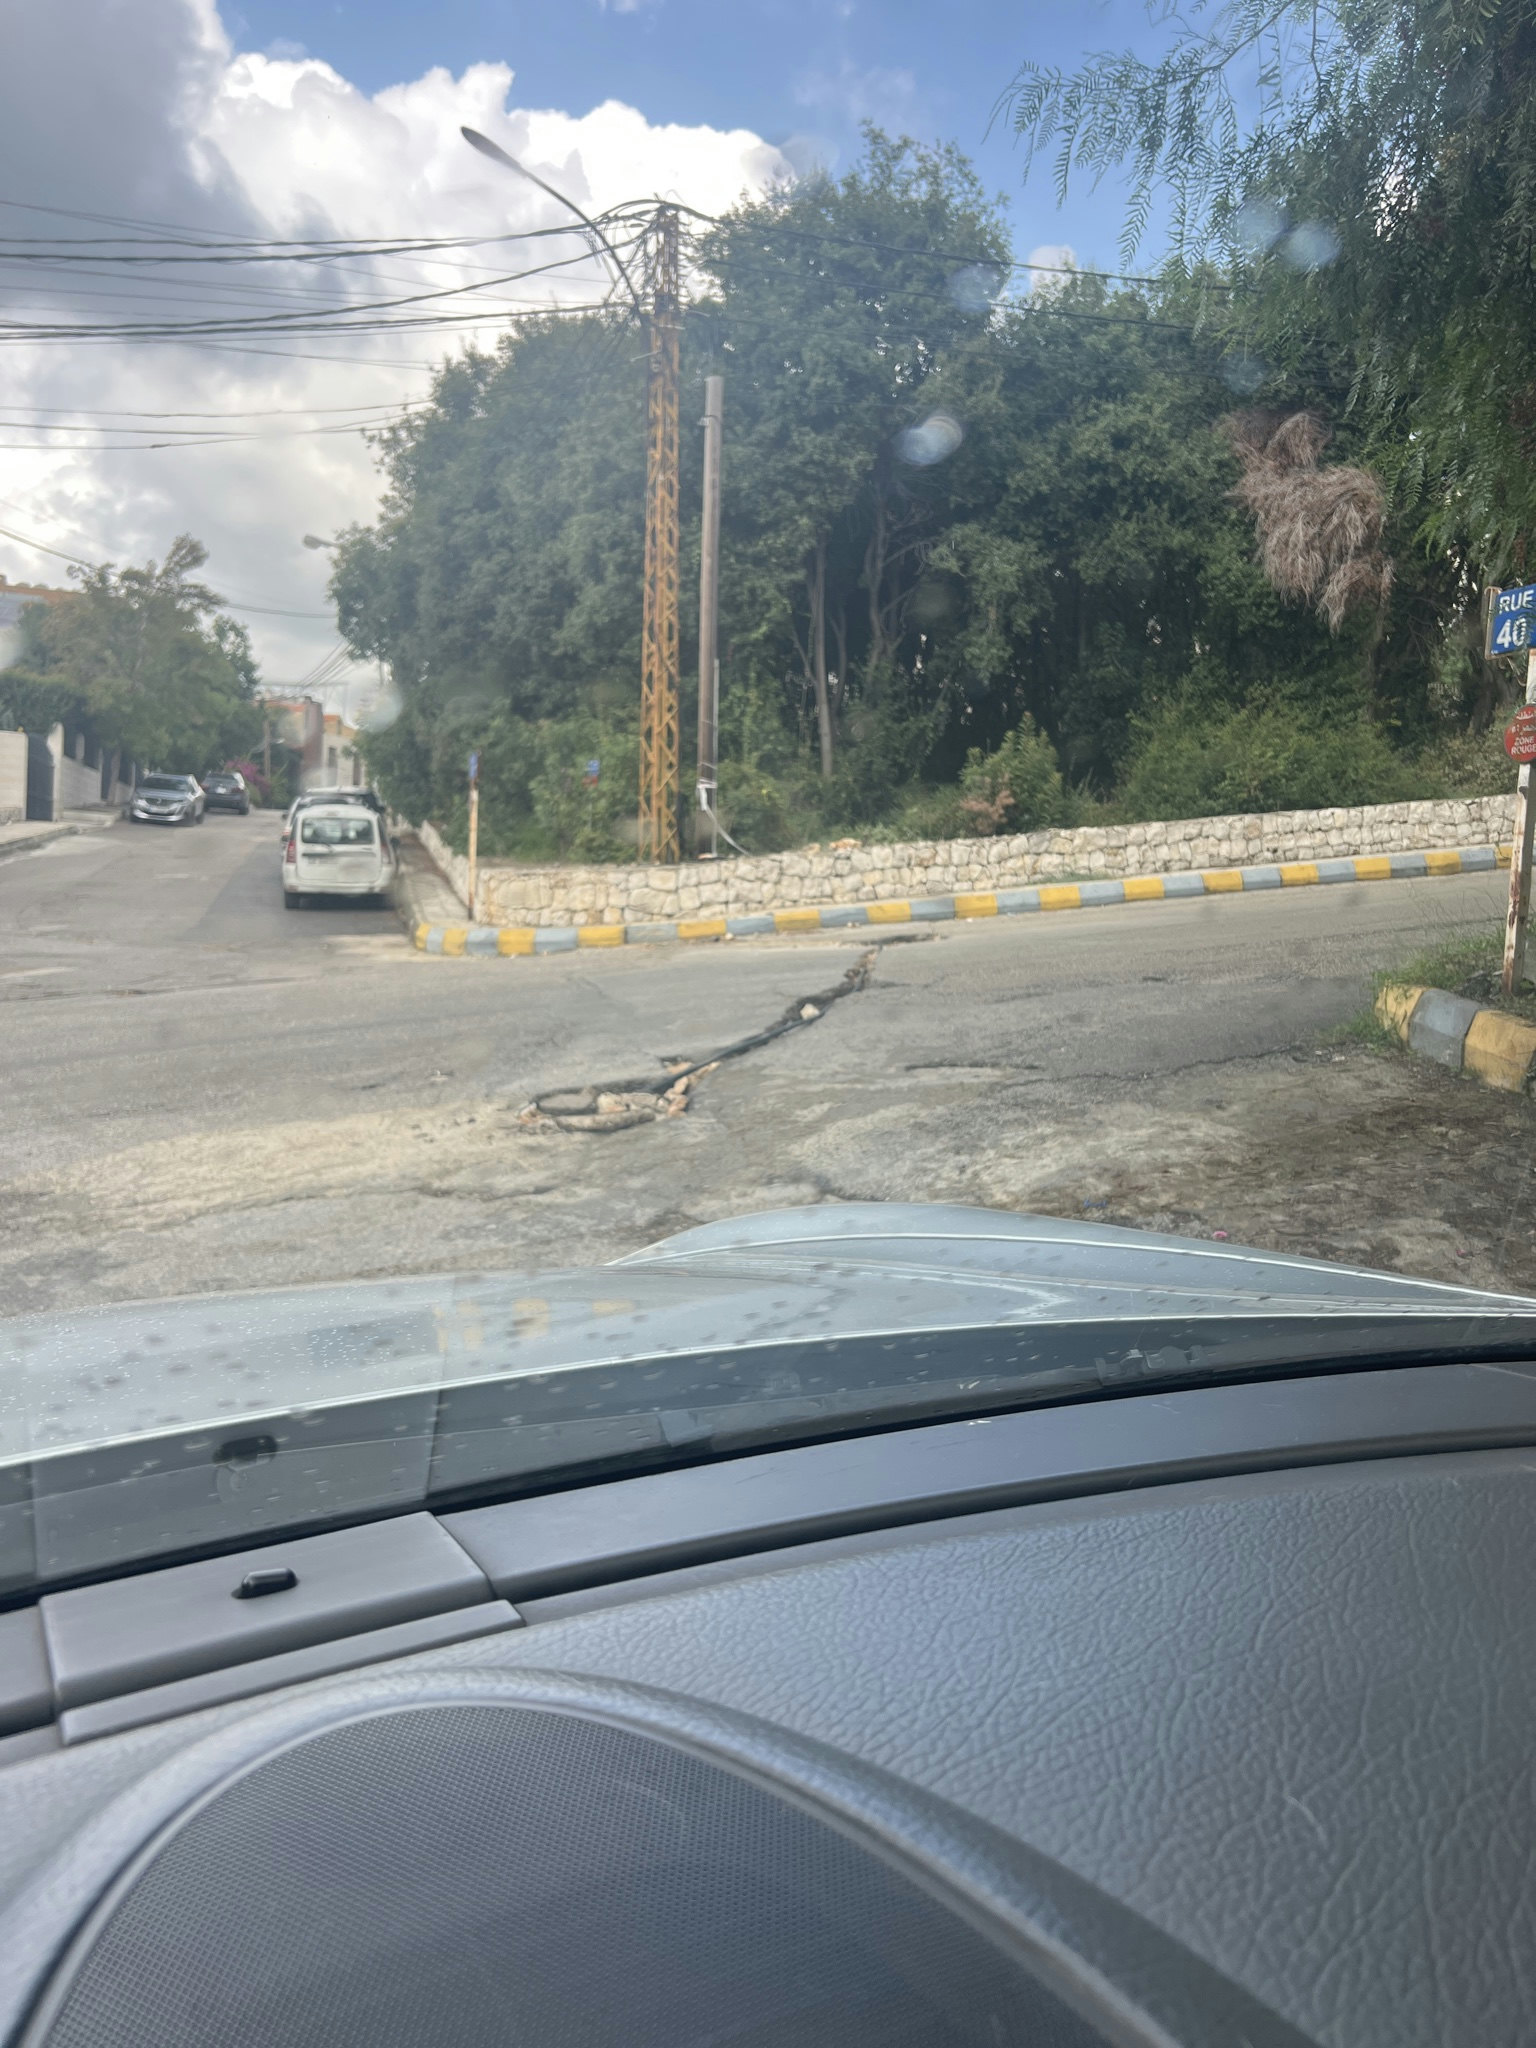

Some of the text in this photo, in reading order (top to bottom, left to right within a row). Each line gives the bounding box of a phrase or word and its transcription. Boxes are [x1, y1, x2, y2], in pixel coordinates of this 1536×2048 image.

[1499, 589, 1534, 614] RUE
[1496, 617, 1527, 649] 40
[1511, 743, 1536, 756] ROUGE
[1514, 736, 1535, 746] ZONE
